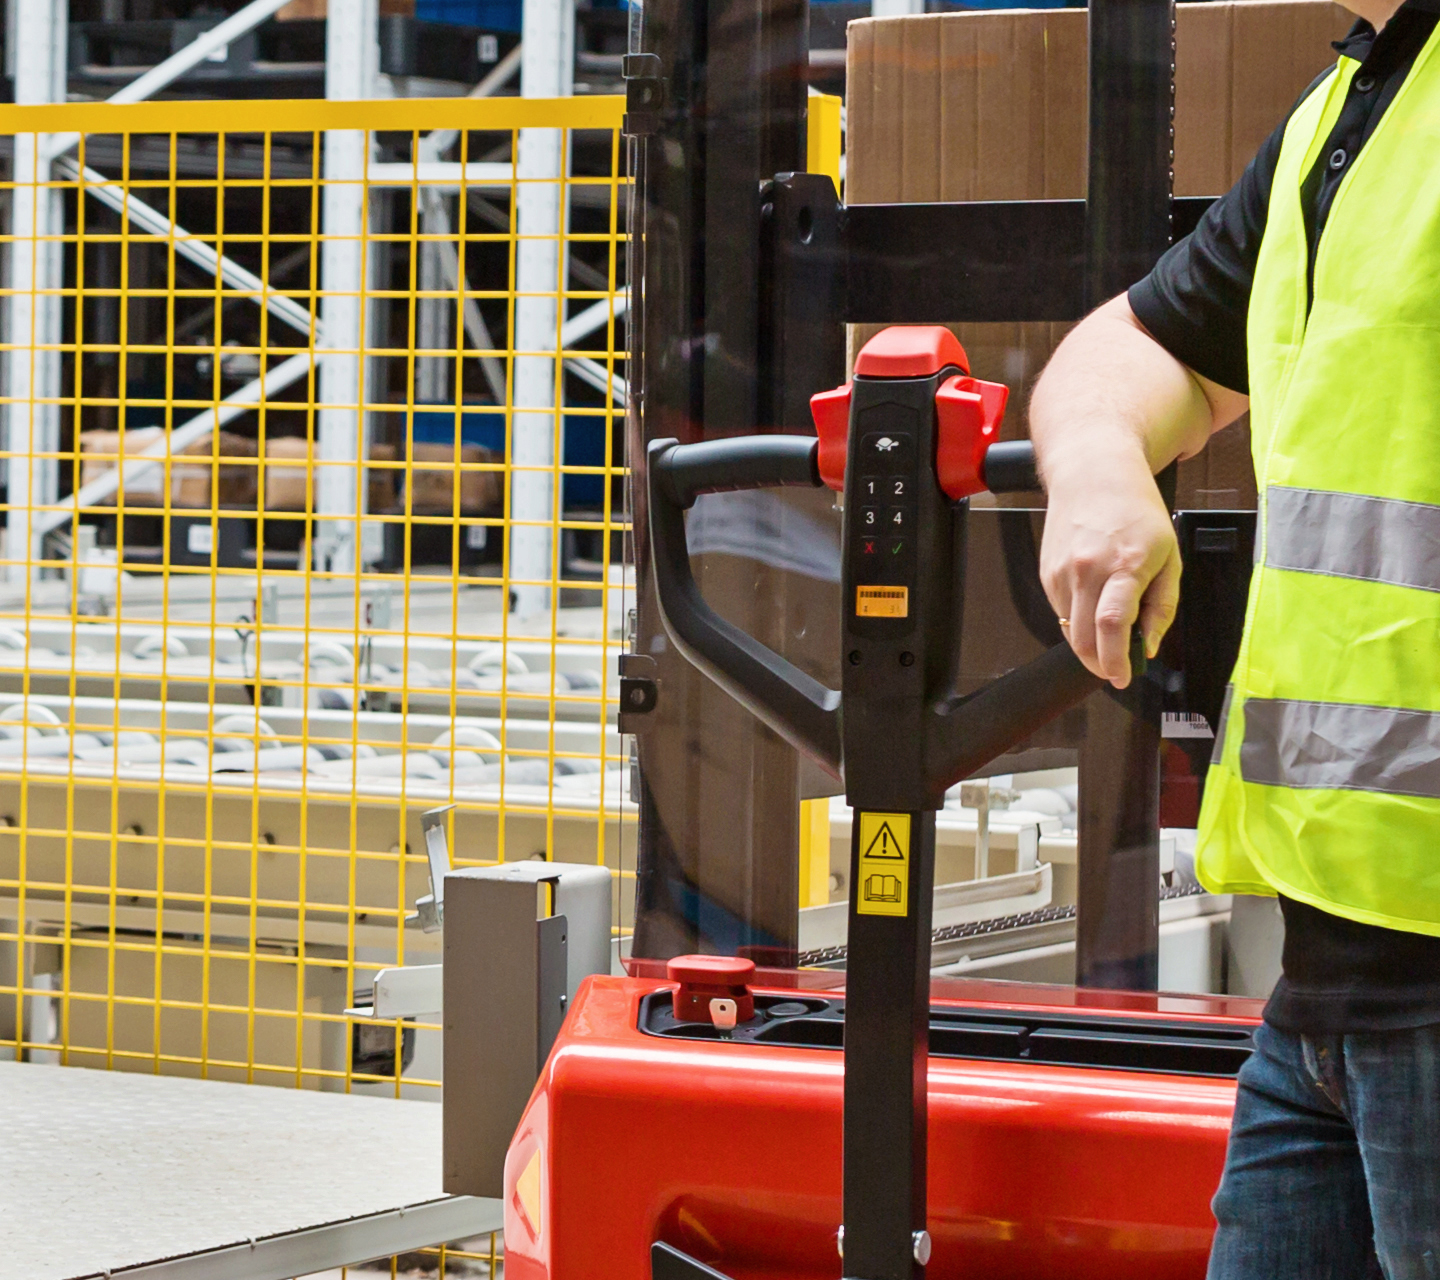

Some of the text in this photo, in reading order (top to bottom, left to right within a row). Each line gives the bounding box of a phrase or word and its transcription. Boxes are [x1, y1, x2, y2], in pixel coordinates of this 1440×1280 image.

[868, 482, 904, 495] 1 2
[865, 511, 902, 524] 3 4
